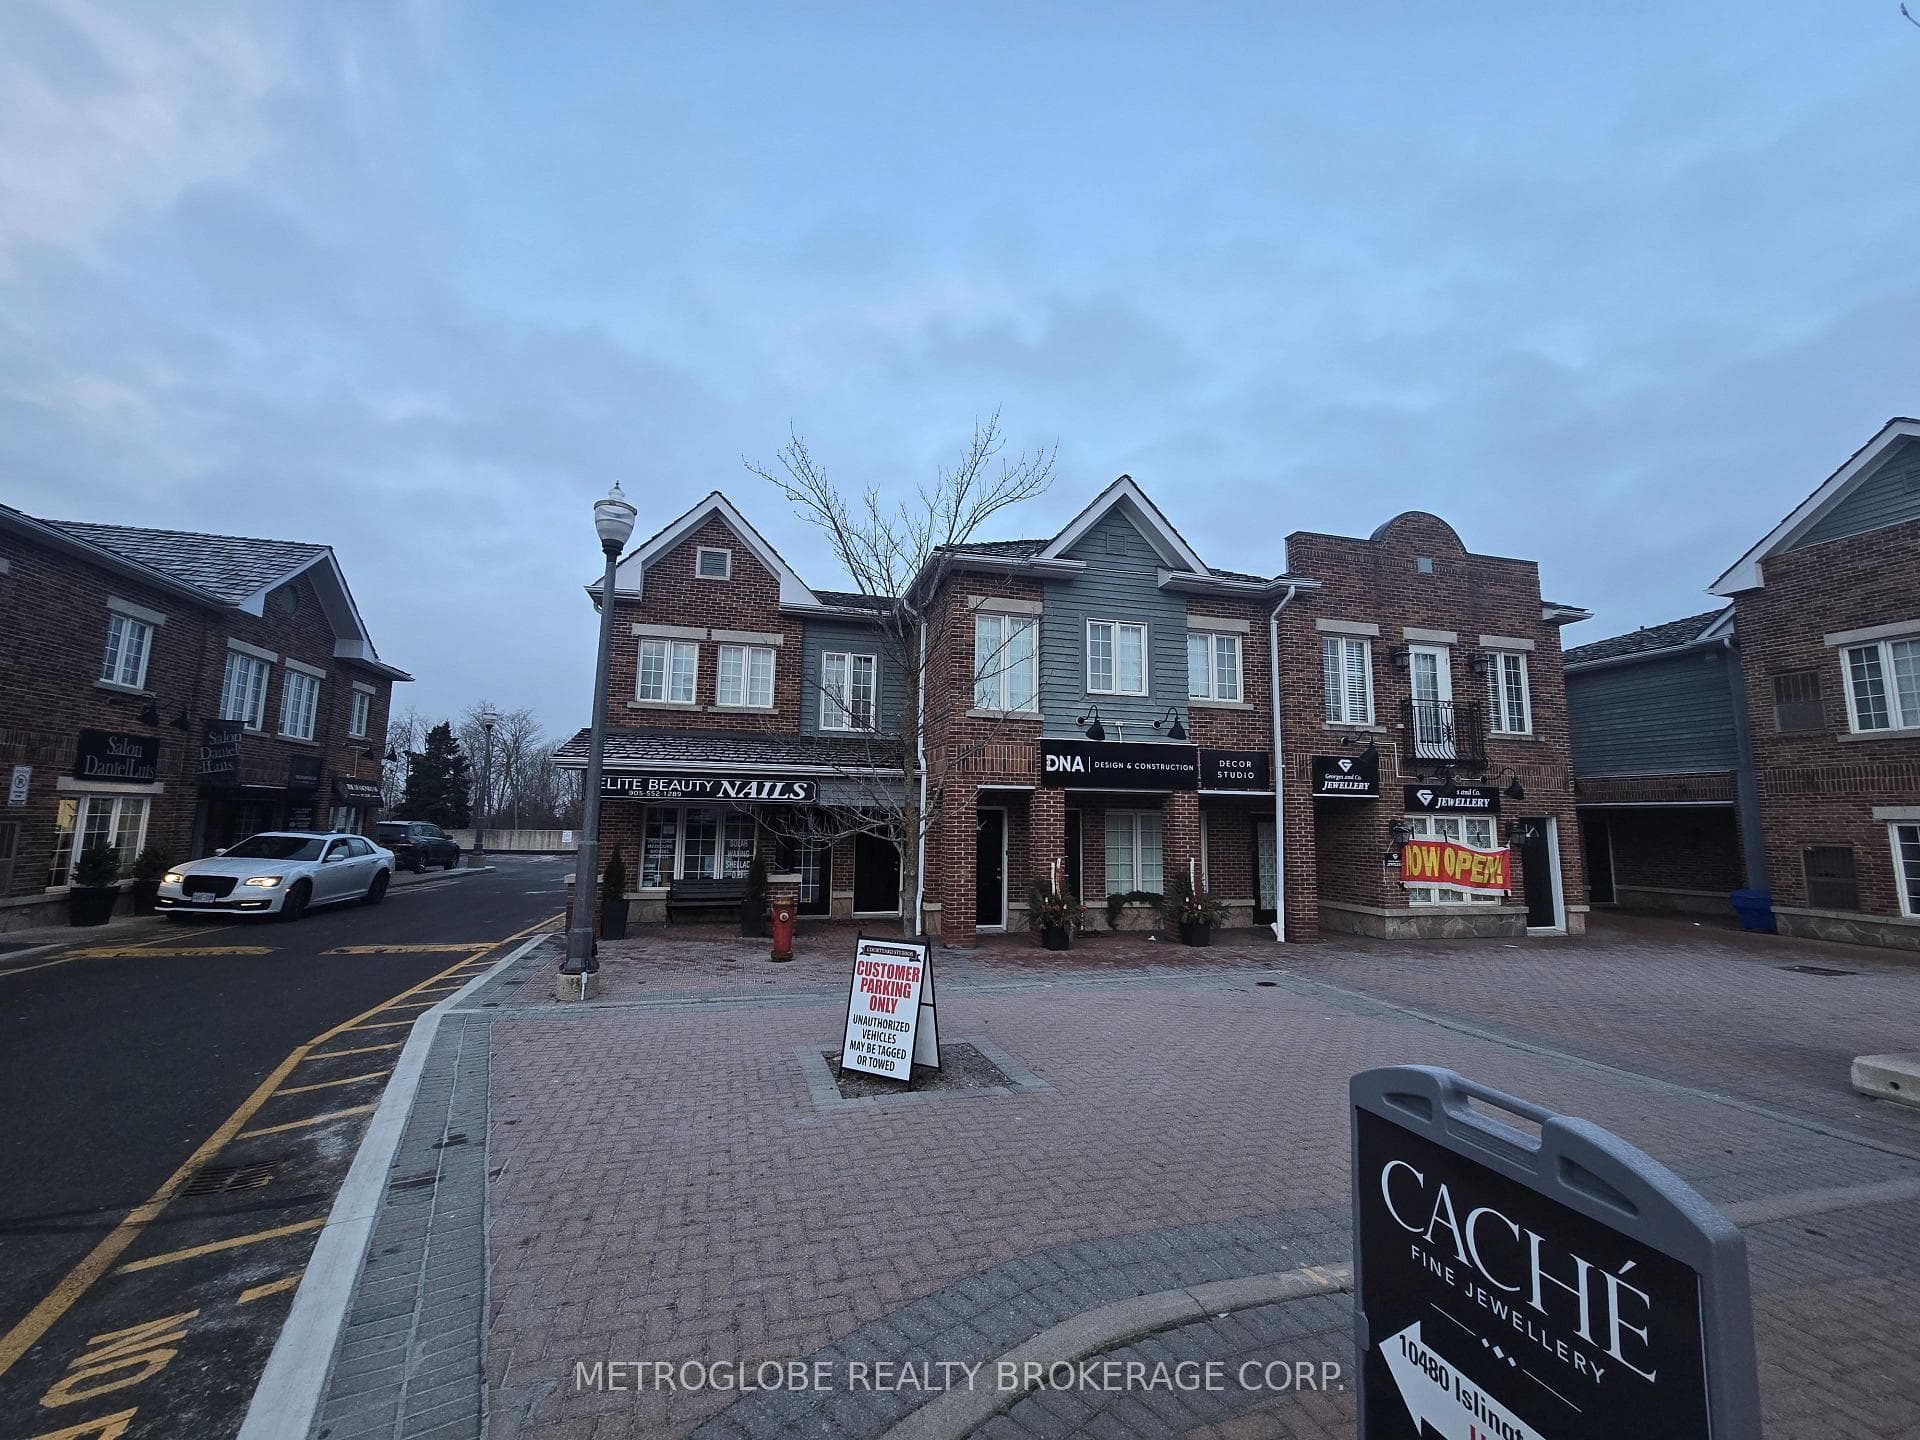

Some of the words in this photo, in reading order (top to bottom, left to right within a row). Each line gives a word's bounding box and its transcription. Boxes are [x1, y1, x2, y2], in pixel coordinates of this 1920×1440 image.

[106, 735, 143, 757] Salon
[1046, 755, 1085, 773] DNA
[1094, 761, 1124, 769] DESIGN
[1134, 762, 1194, 771] CONSTRUCTION
[1219, 760, 1252, 768] DECOR
[1217, 771, 1255, 779] STUDIO
[600, 777, 642, 790] ELITE
[648, 779, 714, 792] BEAUTY
[716, 780, 808, 799] NAILS
[1322, 781, 1370, 791] JEWELLERY
[1435, 797, 1490, 809] JEWELLERY
[1444, 847, 1504, 884] OPEN!
[856, 960, 921, 983] CUSTOMER
[860, 977, 912, 999] PARKING
[869, 995, 899, 1014] ONLY
[853, 1014, 910, 1033] UNAUTHORIZED
[862, 1028, 897, 1044] VEHICLES
[849, 1040, 865, 1052] MAY
[867, 1042, 876, 1054] BE
[878, 1045, 907, 1060] TAGGED
[856, 1055, 868, 1066] OR
[869, 1057, 895, 1072] TOWED
[1381, 1160, 1657, 1383] CACHÉ
[1411, 1244, 1455, 1287] FINE
[1465, 1282, 1605, 1384] JEWELLERY
[1400, 1334, 1450, 1392] 10480
